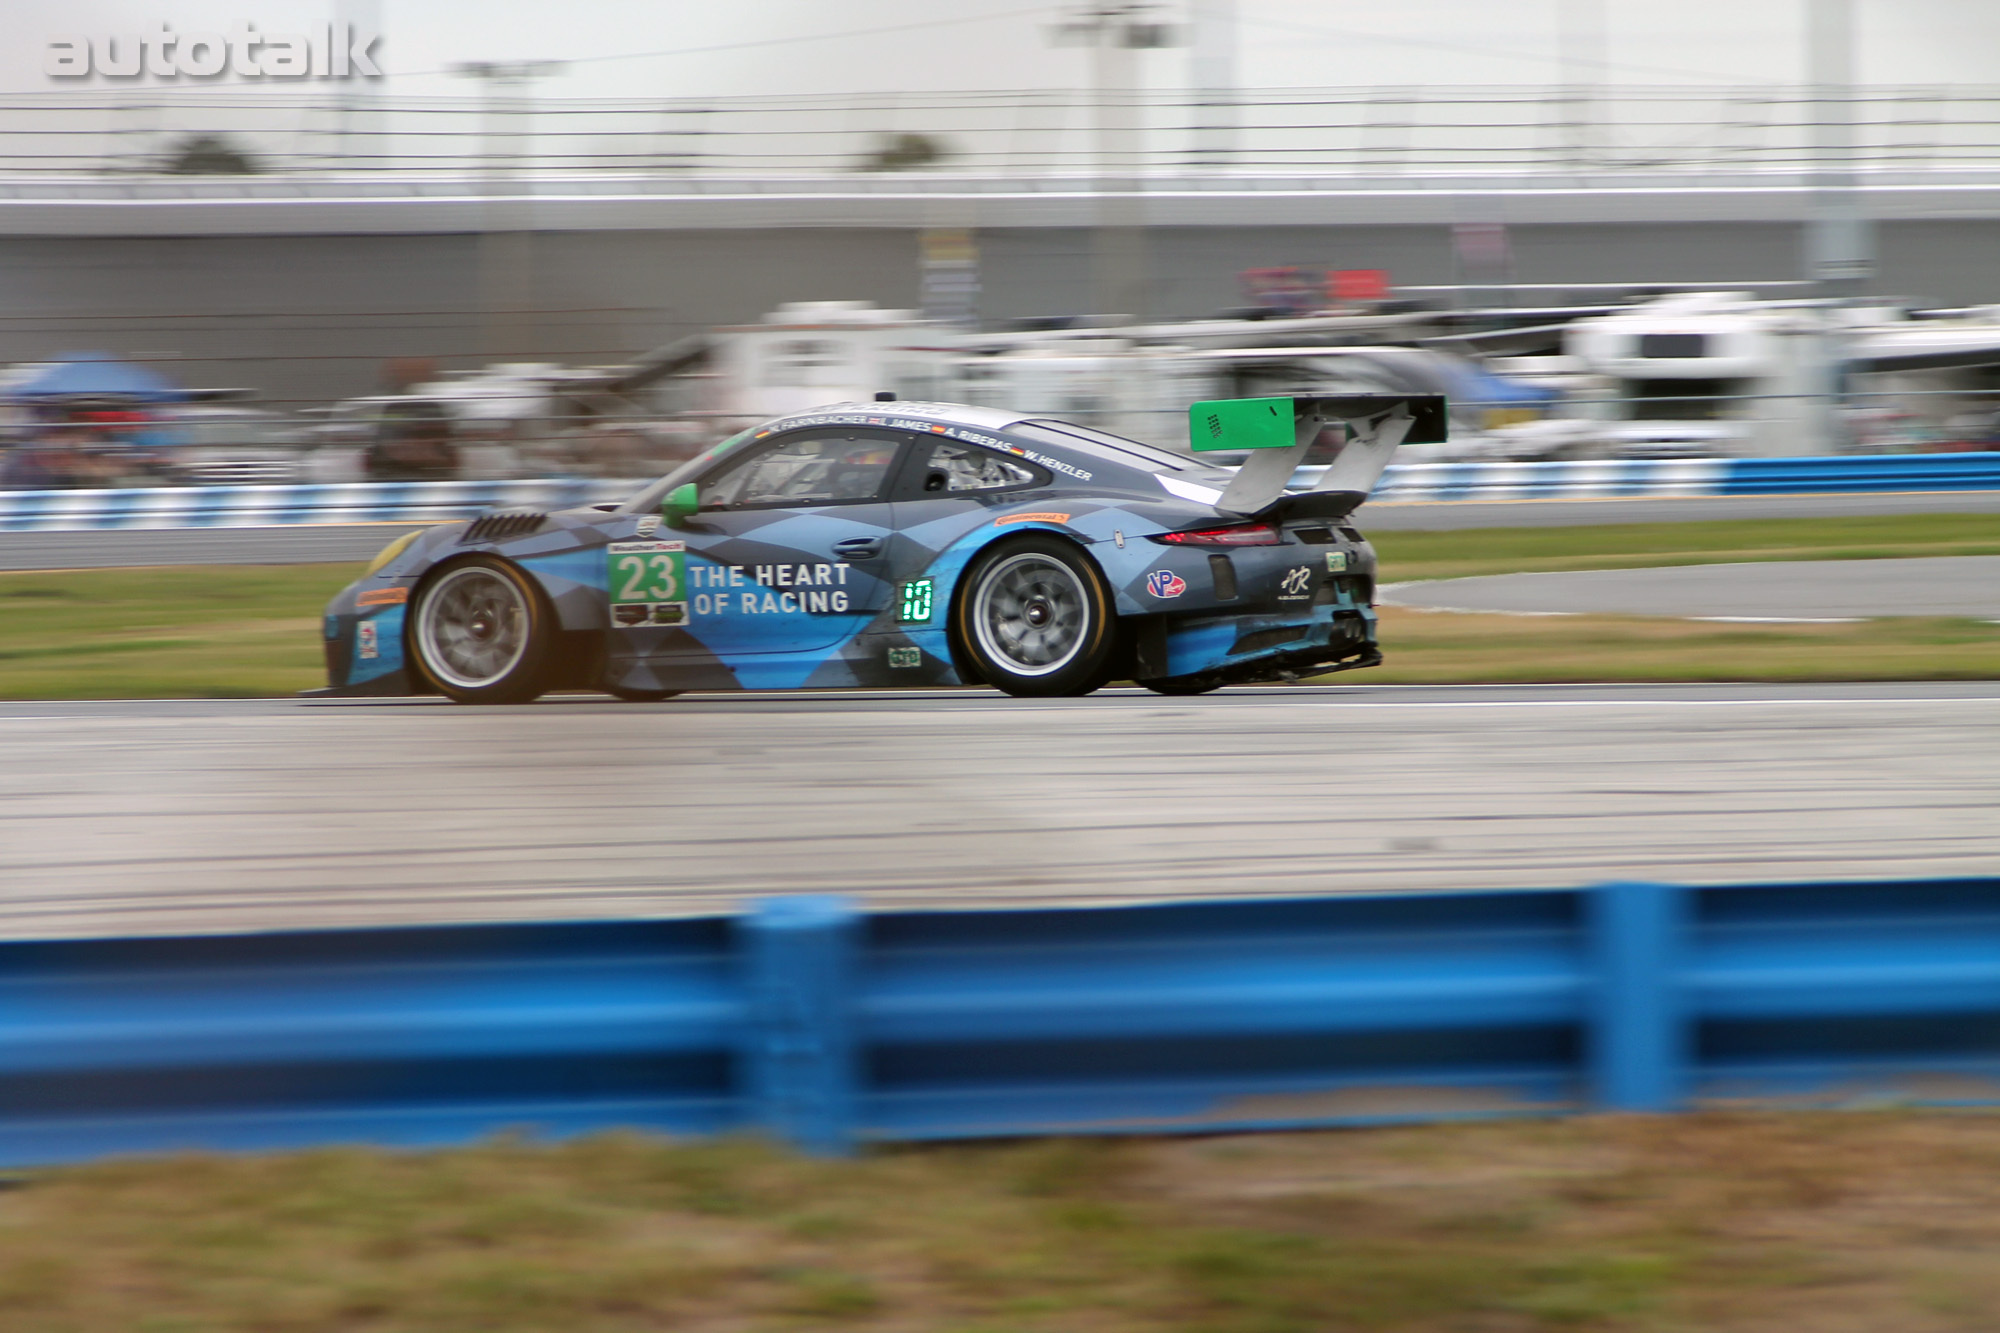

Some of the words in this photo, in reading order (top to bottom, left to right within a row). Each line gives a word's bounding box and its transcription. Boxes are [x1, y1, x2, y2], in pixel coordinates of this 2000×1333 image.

[889, 418, 932, 432] JAMES
[958, 430, 1012, 452] RIBERAS
[617, 554, 678, 600] 23
[689, 565, 745, 588] THE
[756, 563, 850, 587] HEART
[1147, 570, 1174, 597] VP
[694, 592, 730, 616] OF
[740, 590, 849, 614] RACING
[903, 580, 932, 620] 10
